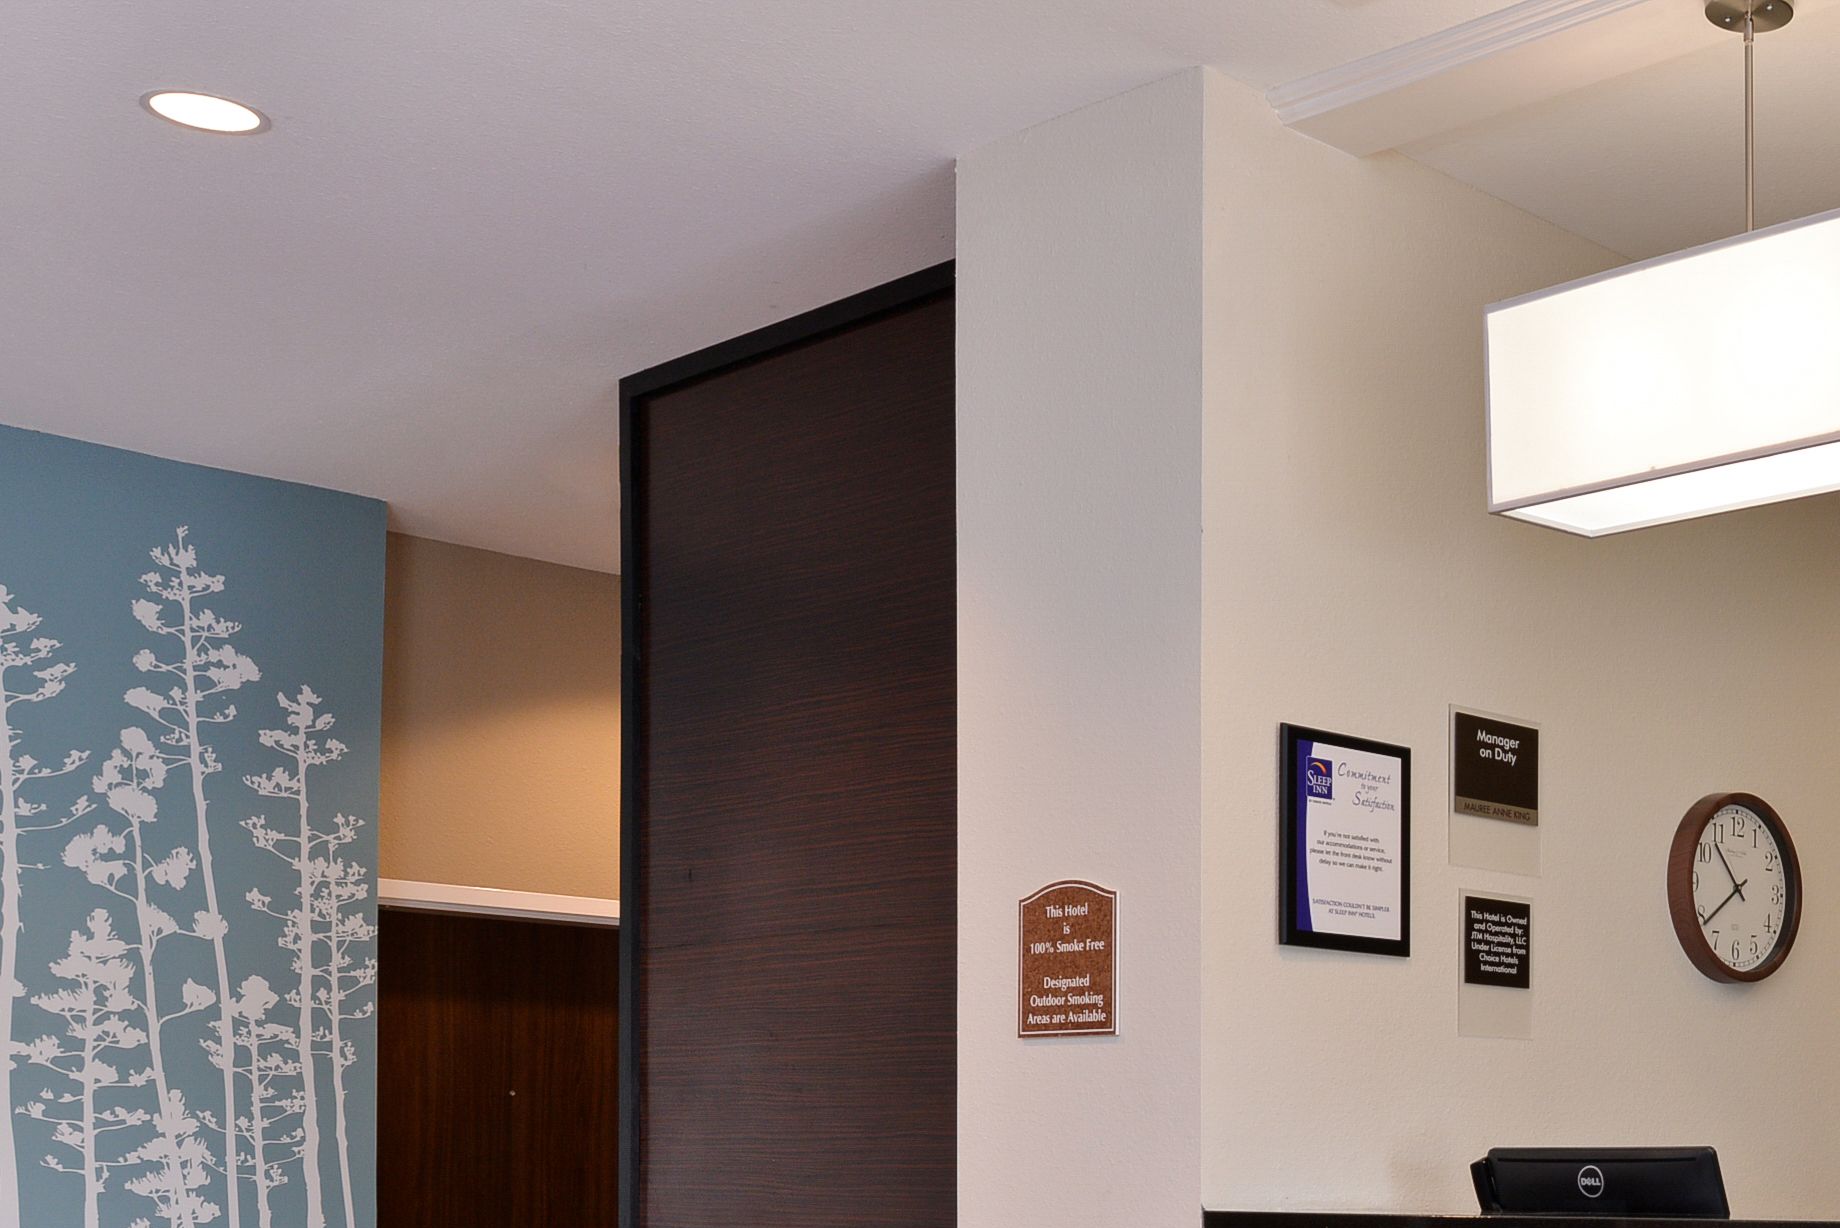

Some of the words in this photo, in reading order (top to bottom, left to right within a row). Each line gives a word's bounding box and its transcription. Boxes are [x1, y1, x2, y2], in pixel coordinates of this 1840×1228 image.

[1477, 729, 1520, 750] Manager
[1480, 748, 1492, 758] on
[1495, 747, 1517, 766] Duty
[1307, 770, 1332, 787] SLEEP
[1338, 762, 1391, 784] Commitment
[1313, 785, 1328, 794] INN
[1352, 791, 1395, 813] Satisfaction
[1492, 807, 1512, 818] ANNE
[1513, 810, 1531, 821] KING
[1712, 822, 1724, 844] 11
[1730, 816, 1745, 838] 12
[1351, 834, 1369, 842] satisfied
[1752, 828, 1758, 848] 1
[1325, 841, 1363, 851] accommodations
[1698, 842, 1712, 864] 10
[1319, 858, 1331, 866] delay
[1765, 852, 1773, 872] 2
[1312, 898, 1342, 907] SATISFACTION
[1771, 885, 1779, 905] 3
[1046, 905, 1063, 918] This
[1065, 902, 1088, 916] Hotel
[1334, 908, 1347, 916] SLEEP
[1471, 910, 1482, 920] This
[1483, 912, 1500, 921] Hotel
[1500, 914, 1505, 922] is
[1506, 915, 1527, 925] Owned
[1063, 922, 1070, 934] is
[1474, 922, 1485, 930] and
[1487, 923, 1514, 934] Operated
[1764, 913, 1771, 933] 4
[1471, 931, 1483, 940] JTM
[1483, 933, 1514, 945] Hospitality,
[1516, 936, 1527, 945] LLC
[1712, 930, 1720, 950] 7
[1750, 935, 1758, 955] 5
[1030, 942, 1054, 954] 100%
[1056, 939, 1084, 952] Smoke
[1086, 939, 1105, 951] Free
[1471, 941, 1489, 950] Under
[1490, 944, 1511, 953] License
[1512, 945, 1526, 955] from
[1731, 939, 1739, 960] 6
[1479, 952, 1499, 962] Choice
[1500, 955, 1519, 964] Hotels
[1480, 963, 1517, 974] International
[1044, 974, 1090, 991] Designated
[1030, 994, 1065, 1007] Outdoor
[1067, 992, 1104, 1007] Smoking
[1027, 1013, 1049, 1024] Areas
[1052, 1014, 1065, 1023] are
[1067, 1009, 1106, 1023] Available
[1581, 1177, 1601, 1186] DELL
